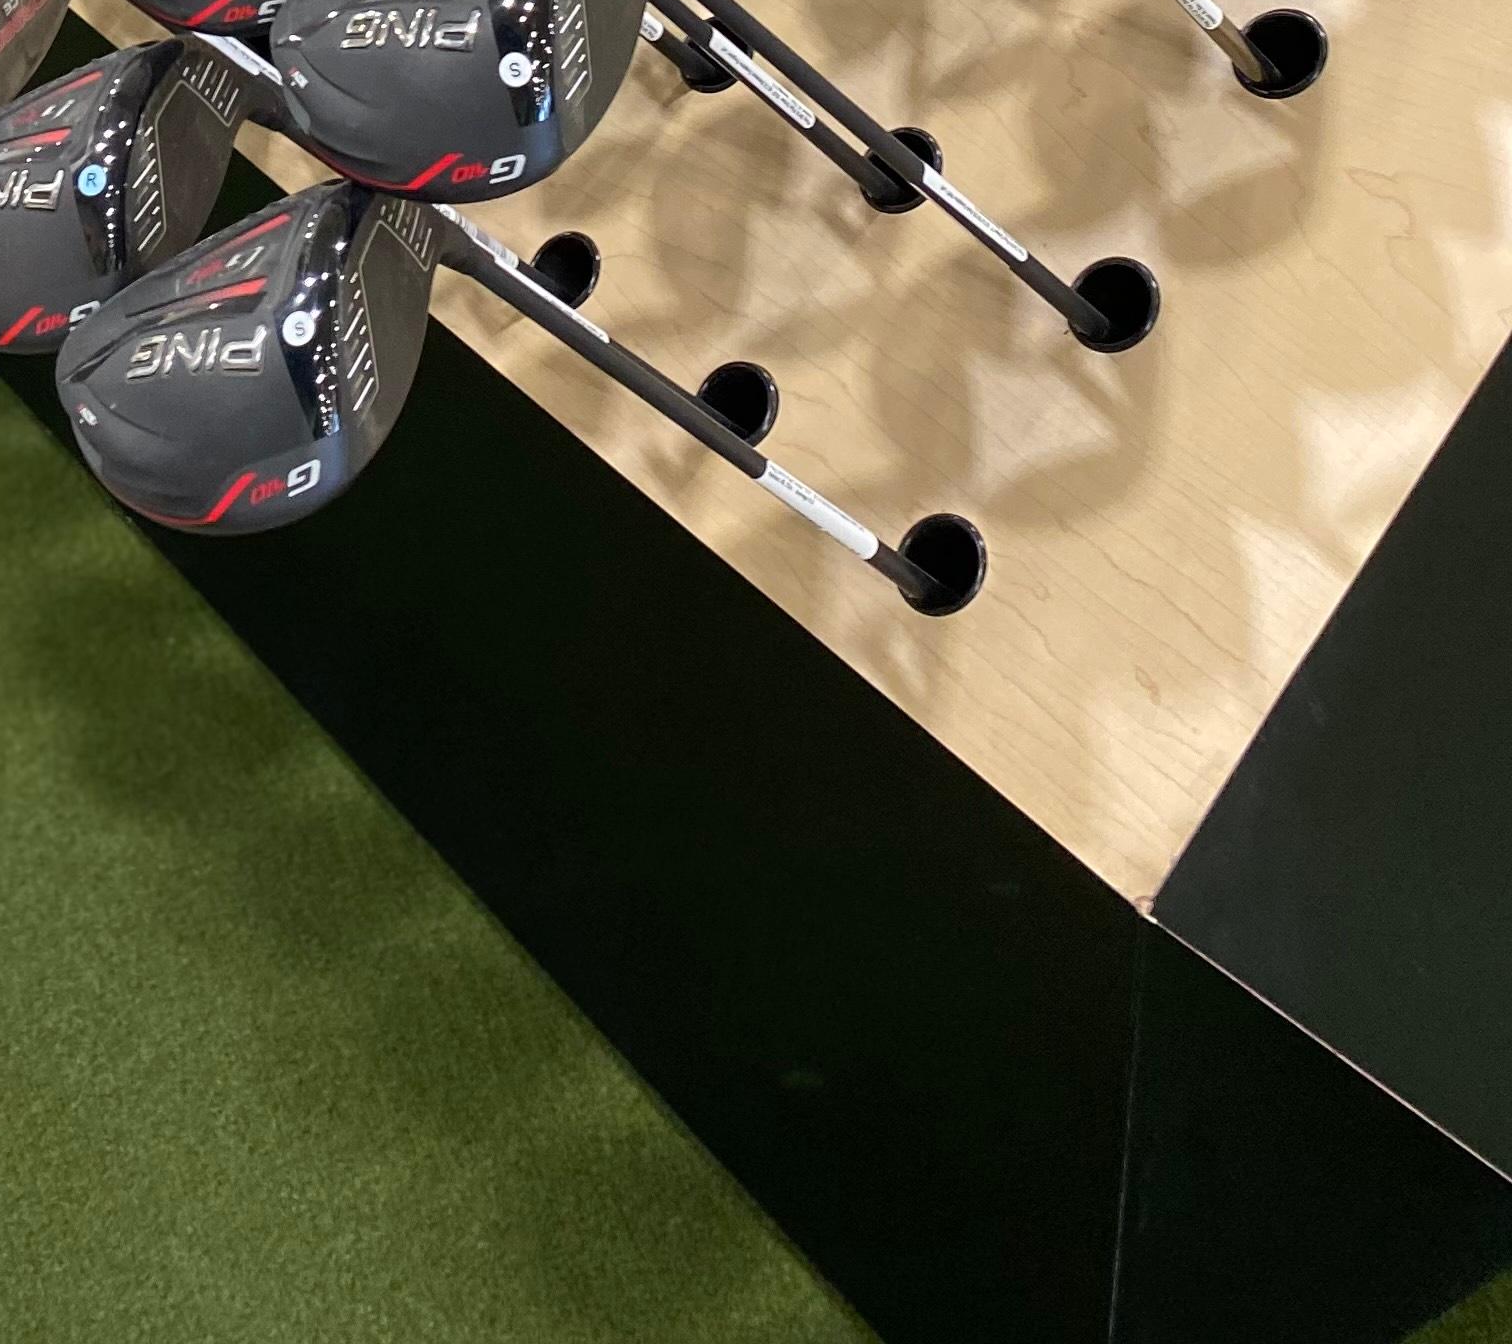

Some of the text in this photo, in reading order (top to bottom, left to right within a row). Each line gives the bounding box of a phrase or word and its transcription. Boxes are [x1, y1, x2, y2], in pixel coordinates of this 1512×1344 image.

[338, 7, 485, 52] PING
[509, 62, 521, 78] S
[450, 153, 527, 187] G410
[34, 300, 101, 336] G410
[125, 327, 269, 383] PING
[250, 458, 322, 505] G410
